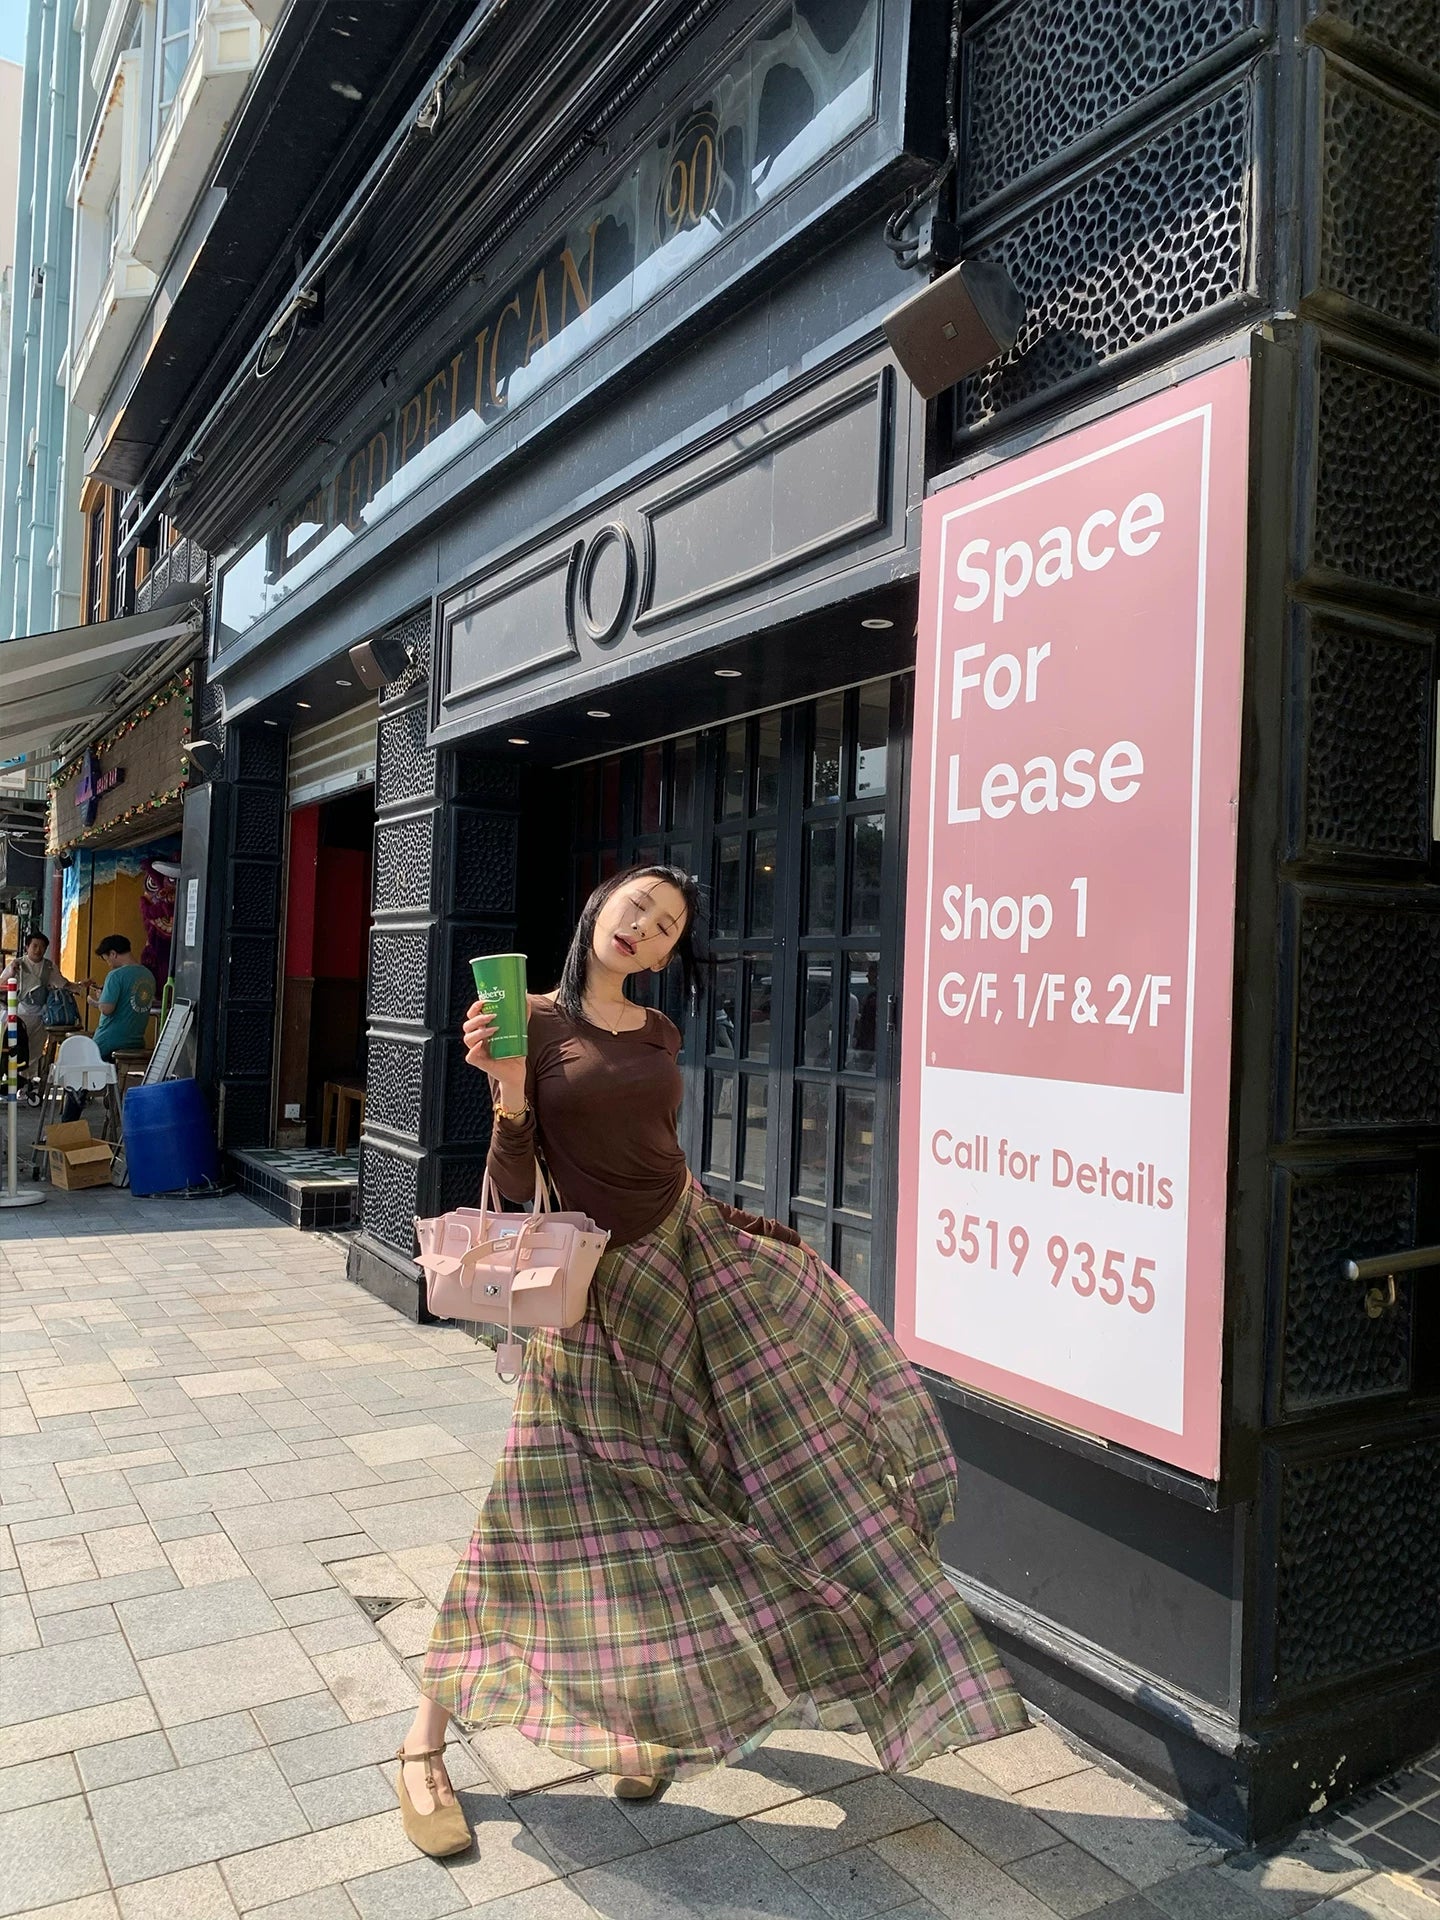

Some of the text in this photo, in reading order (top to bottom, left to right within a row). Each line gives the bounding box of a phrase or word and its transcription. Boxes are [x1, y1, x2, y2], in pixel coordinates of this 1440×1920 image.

[953, 492, 1165, 623] Space
[951, 641, 1051, 720] For
[947, 740, 1144, 824] Lease
[940, 877, 1088, 954] Shop 1
[937, 971, 1173, 1034] G/F, 1/F & 2/F
[931, 1129, 1175, 1211] Call for Details
[936, 1208, 1157, 1315] 3519 9355
